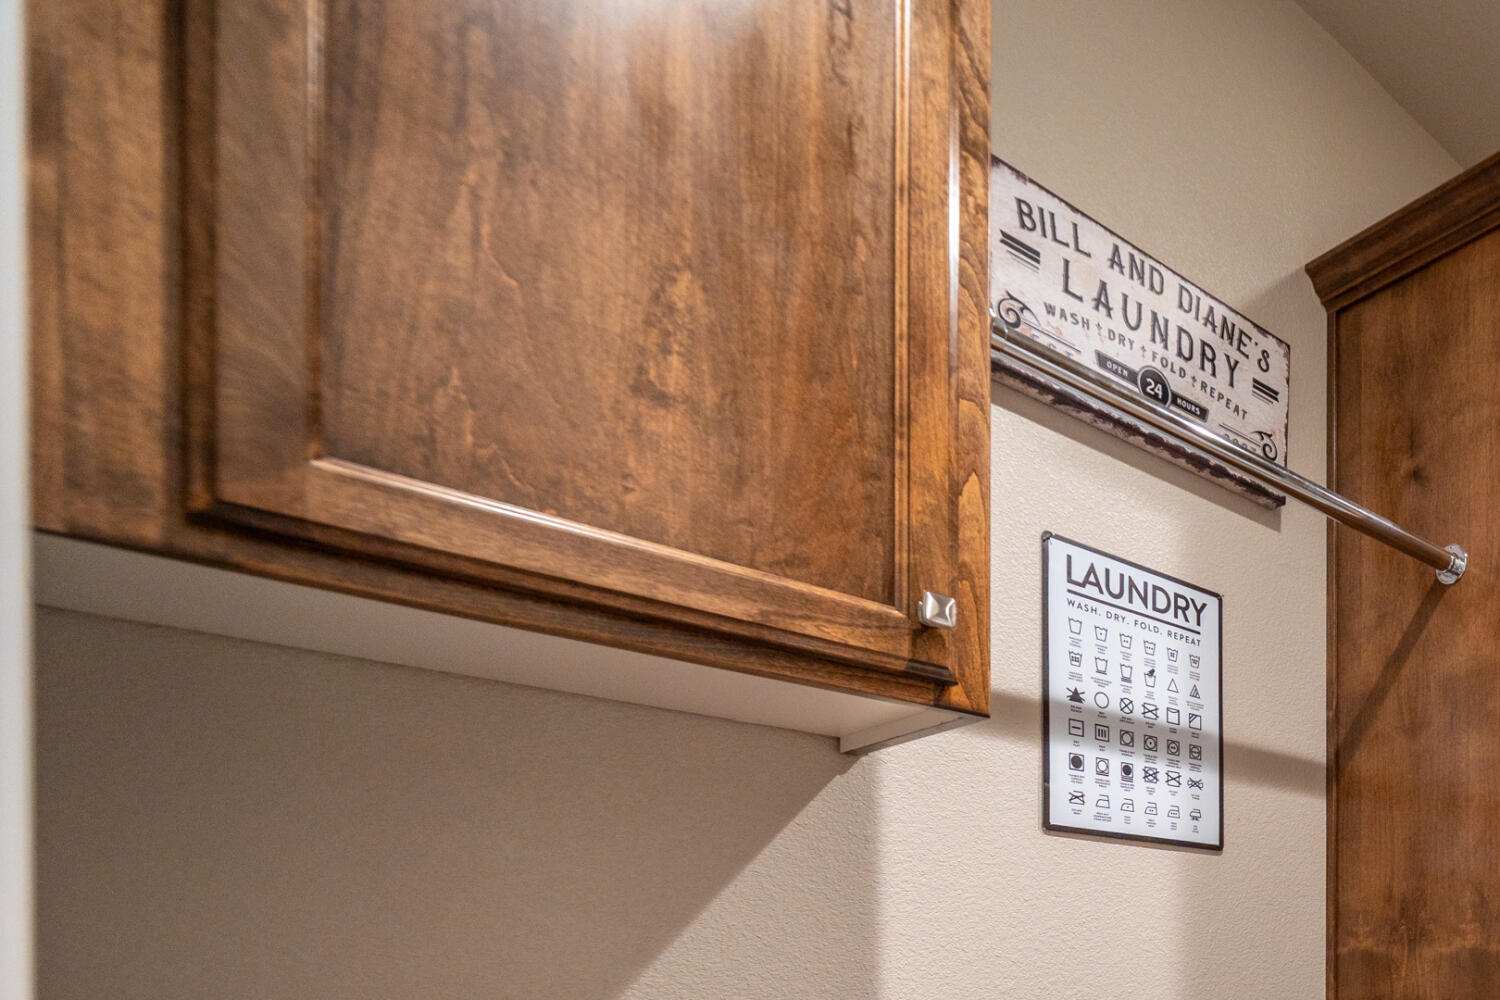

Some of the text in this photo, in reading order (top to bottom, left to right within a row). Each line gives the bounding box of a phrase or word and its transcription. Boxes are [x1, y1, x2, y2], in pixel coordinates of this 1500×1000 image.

[1014, 196, 1270, 373] BILL AND DIANE'S
[1061, 257, 1240, 388] LAUNDRY
[1044, 302, 1247, 420] WASH DRY FOLD REPEAT
[1106, 360, 1200, 415] OPEN 24 HOURS
[1066, 554, 1207, 627] LAUNDRY
[1167, 630, 1201, 647] REPEAT
